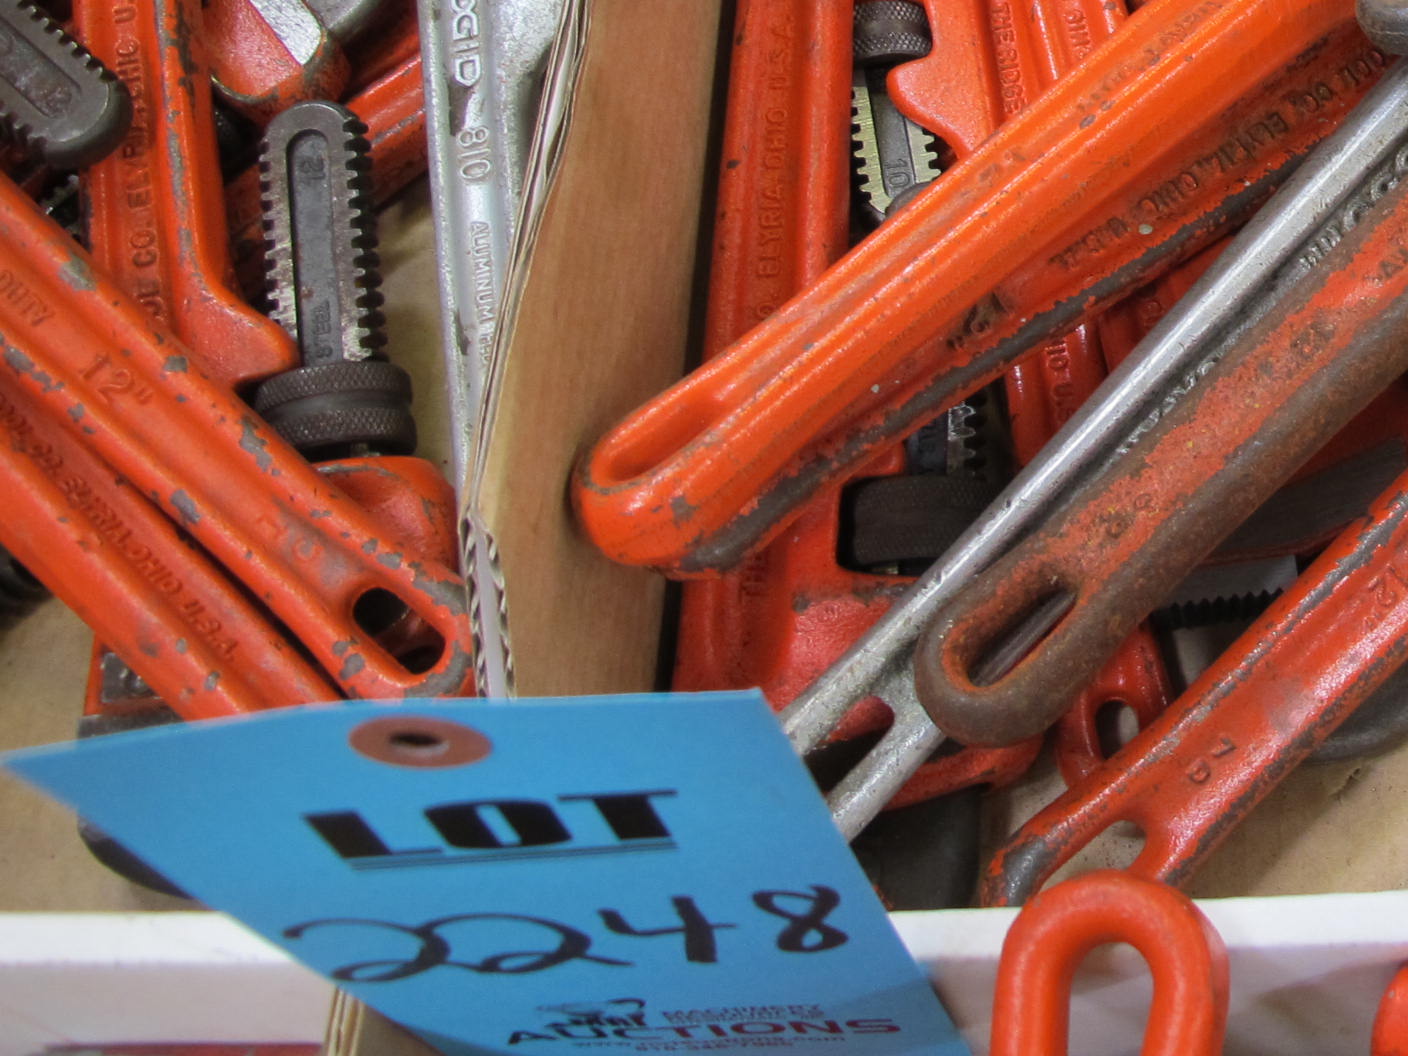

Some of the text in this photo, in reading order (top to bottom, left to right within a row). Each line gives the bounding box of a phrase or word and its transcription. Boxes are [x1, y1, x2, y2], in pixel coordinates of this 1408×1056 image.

[991, 4, 1016, 45] THE
[456, 126, 491, 180] 810
[469, 221, 498, 323] ALUMINUM
[301, 789, 678, 859] LOT
[282, 885, 850, 984] 2248
[507, 1018, 901, 1045] AUCTIONS
